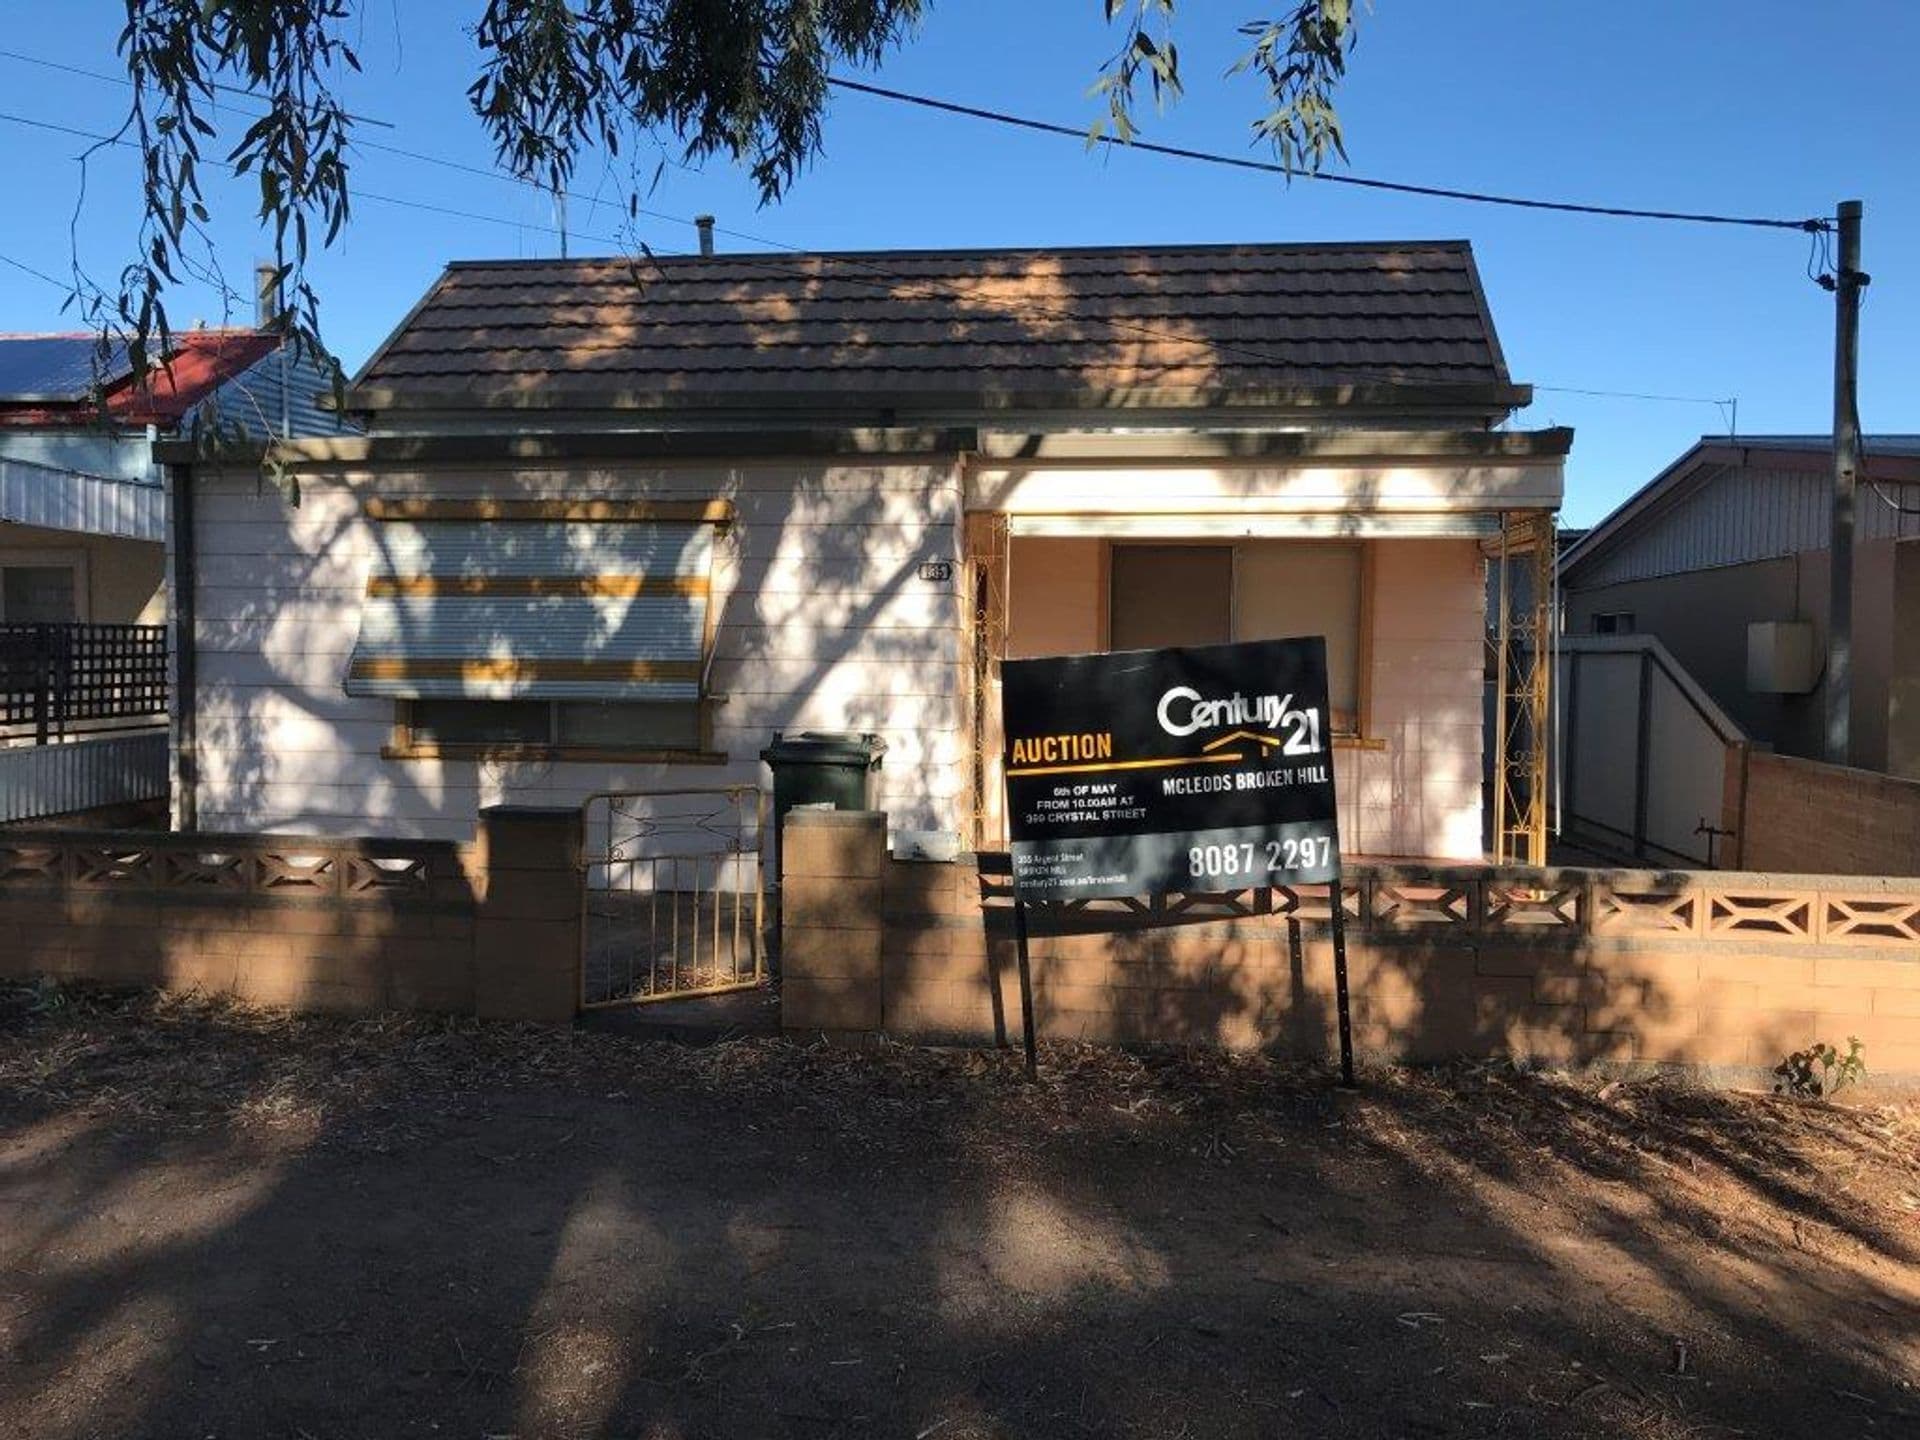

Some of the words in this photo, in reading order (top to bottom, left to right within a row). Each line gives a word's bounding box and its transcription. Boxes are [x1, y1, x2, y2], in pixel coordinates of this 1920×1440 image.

[1157, 686, 1292, 736] Century
[1282, 708, 1321, 756] 21
[1012, 733, 1112, 764] AUCTION
[1073, 785, 1089, 796] OF
[1091, 784, 1118, 795] MAY
[1162, 775, 1232, 796] MCLEODS
[1235, 768, 1294, 791] BROKEN
[1297, 765, 1328, 785] HILL
[1036, 799, 1070, 810] FROM
[1120, 795, 1135, 806] AT
[1048, 811, 1100, 823] CRYSTAL
[1102, 808, 1147, 821] STREET
[1188, 843, 1255, 878] 8087
[1266, 836, 1331, 872] 2297
